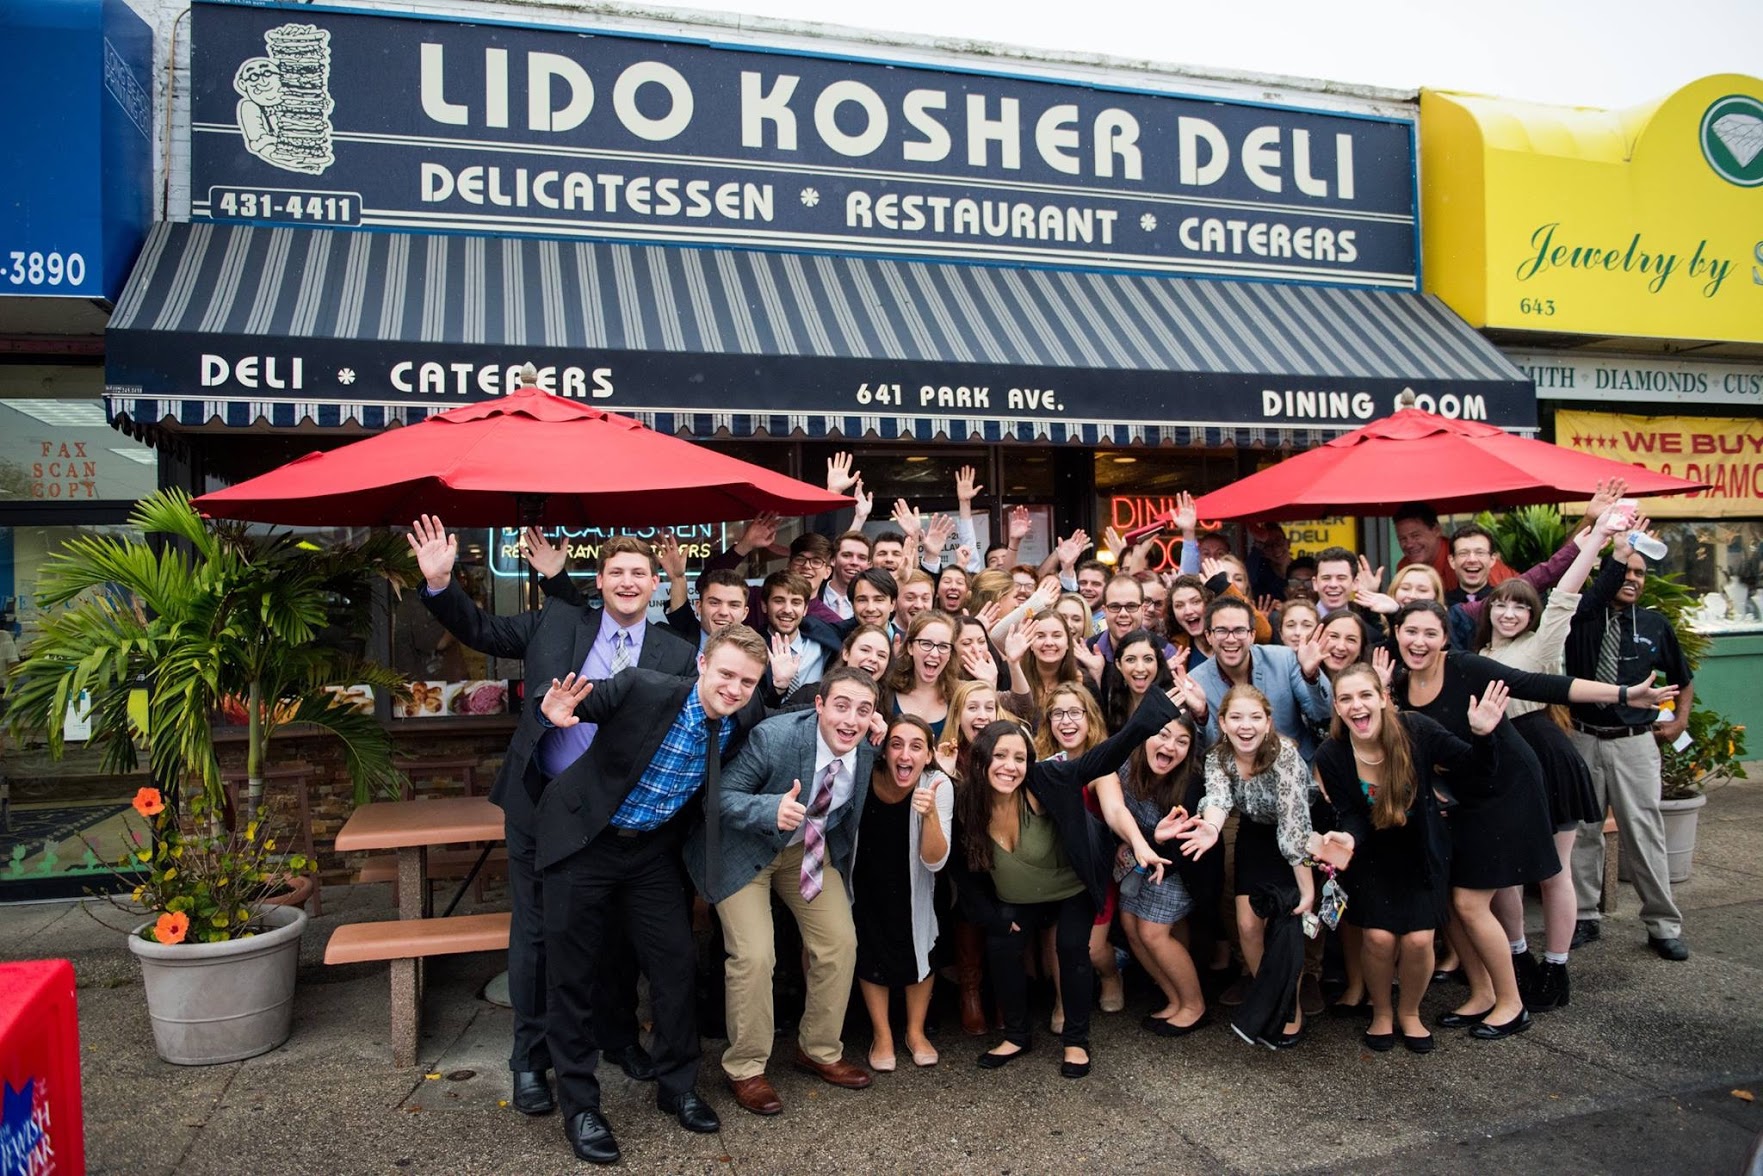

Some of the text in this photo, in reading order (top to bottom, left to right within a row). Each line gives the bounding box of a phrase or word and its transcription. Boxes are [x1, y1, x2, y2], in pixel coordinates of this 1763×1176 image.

[421, 43, 1355, 200] LIDO KOSHER DELI
[220, 192, 350, 222] 431-4411
[421, 162, 1358, 262] DELICATESSEN RESTAURANT CATERERS
[1516, 222, 1685, 294] Jewelry
[1689, 239, 1740, 298] by
[1520, 298, 1556, 316] 643
[201, 354, 303, 389] DELI
[1596, 368, 1708, 394] DIAMONDS
[1724, 373, 1763, 395] CUS
[856, 383, 1065, 411] 641 PARK AVE.
[1262, 390, 1375, 419] DINING
[41, 441, 87, 458] FAX
[1622, 431, 1763, 455] WE BUY
[32, 461, 97, 478] SCAN
[32, 481, 96, 498] COPY
[1112, 497, 1223, 530] DINI
